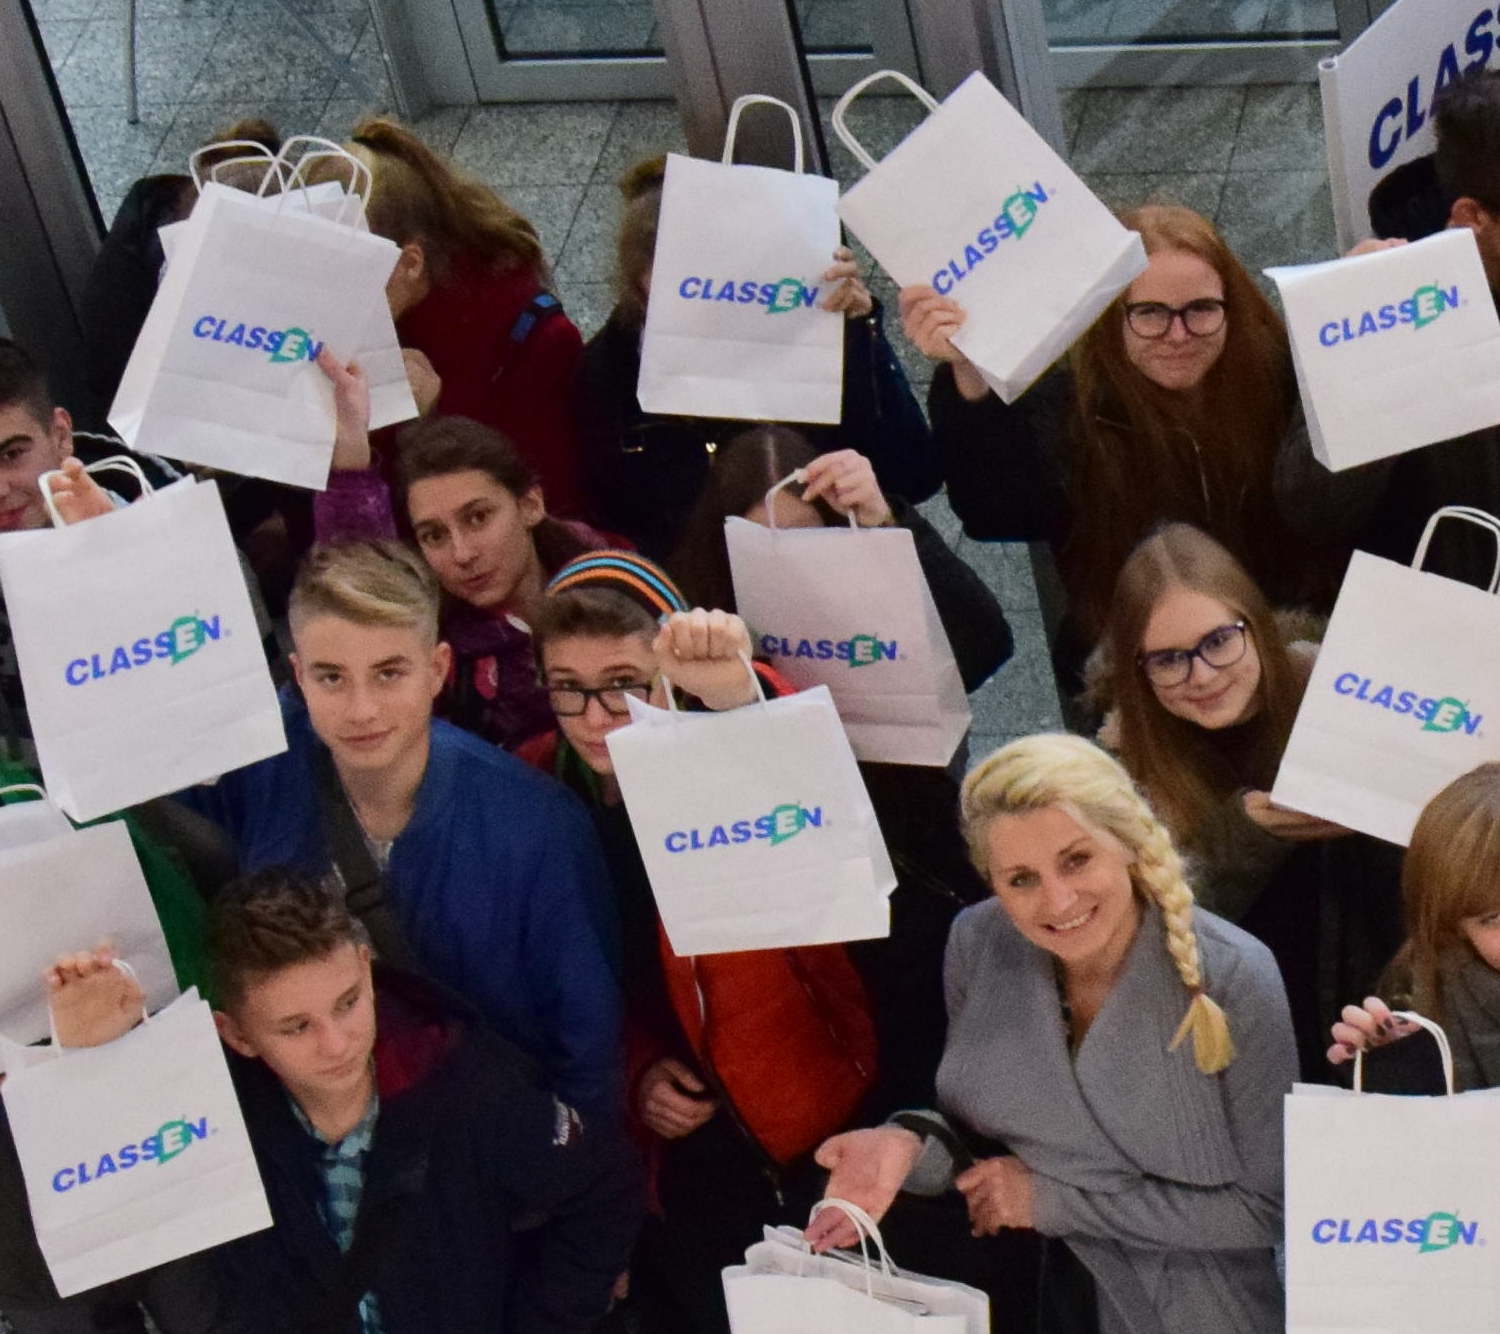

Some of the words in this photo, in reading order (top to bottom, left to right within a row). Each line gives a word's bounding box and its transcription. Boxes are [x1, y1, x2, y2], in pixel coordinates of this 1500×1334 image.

[933, 184, 1047, 294] CLASSEN
[679, 278, 818, 313] CLASSEN
[1320, 286, 1458, 346] CLASSEN
[66, 617, 220, 686] CLASSEN
[764, 635, 897, 666] CLASSEN
[1335, 674, 1481, 734] CLASSEN
[665, 805, 821, 853] CLASSEN
[53, 1119, 207, 1192] CLASSEN
[1312, 1213, 1476, 1252] CLASSEN
